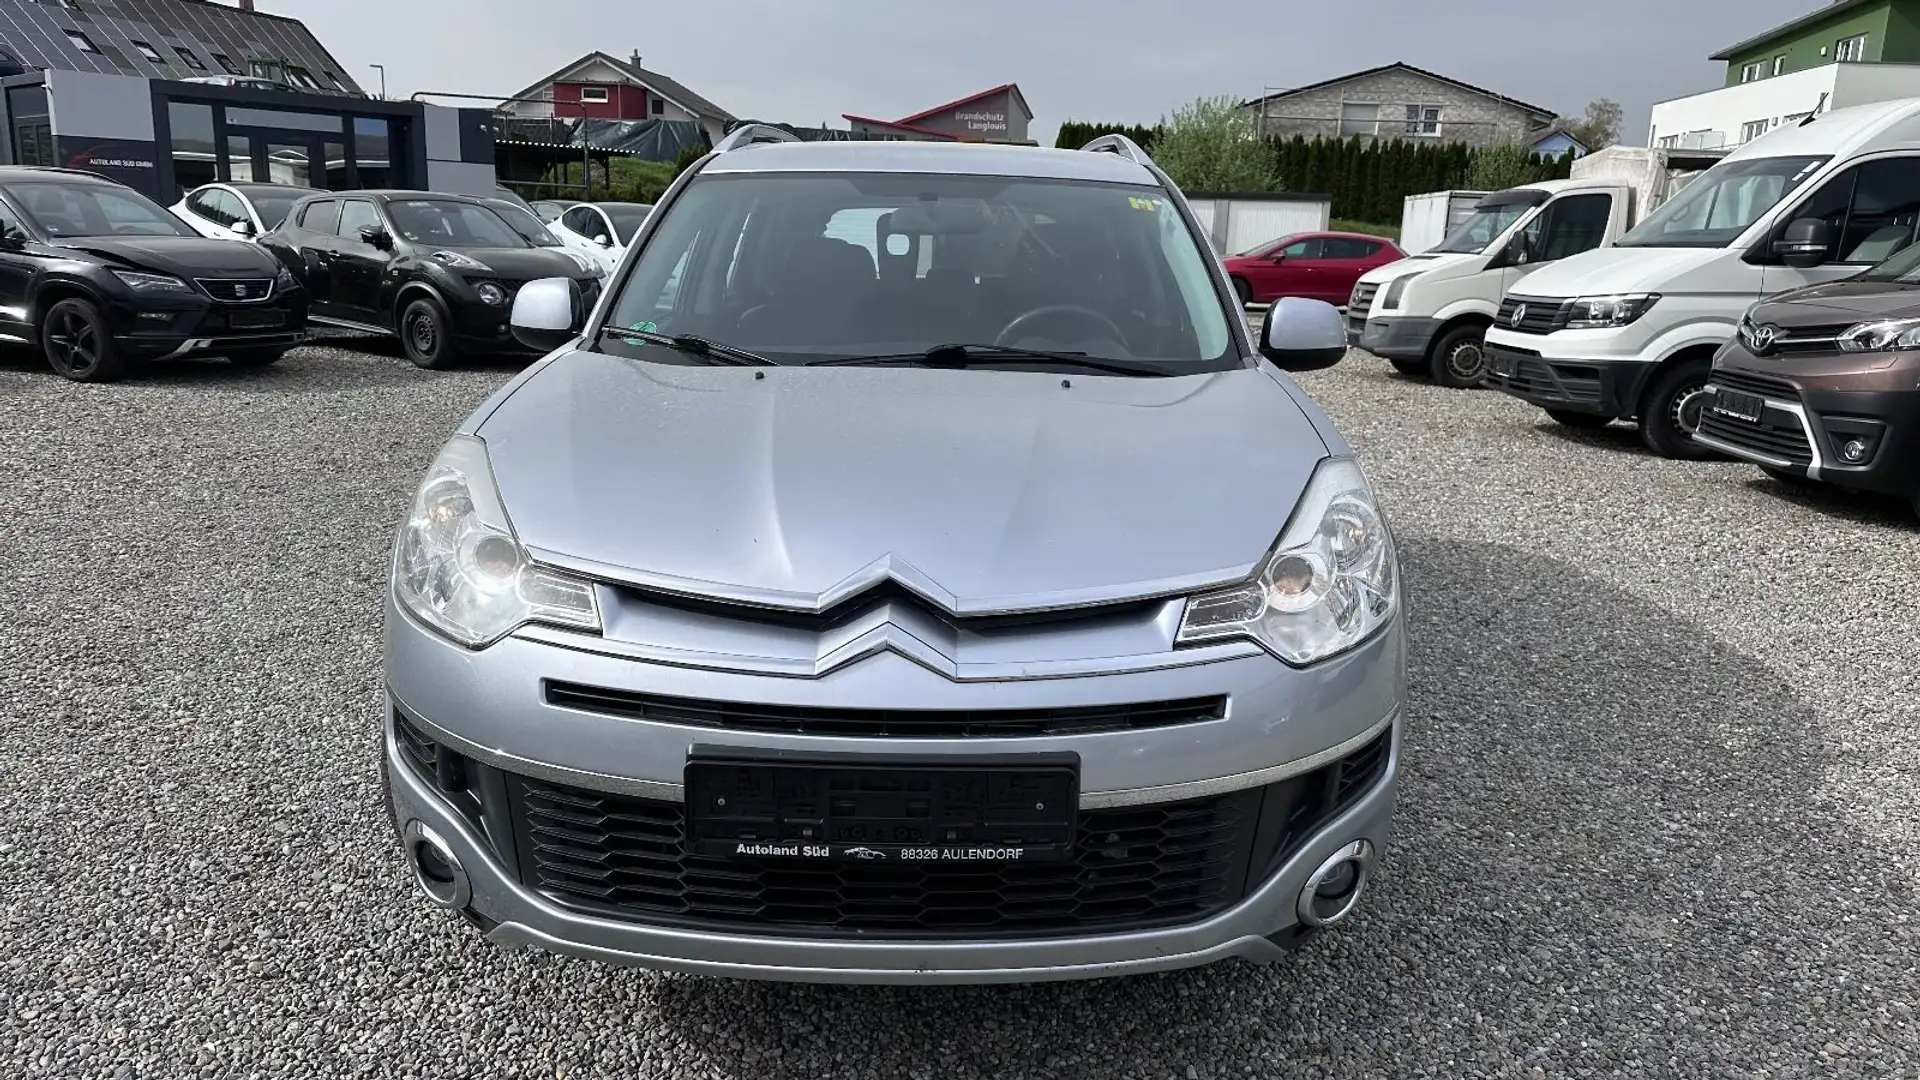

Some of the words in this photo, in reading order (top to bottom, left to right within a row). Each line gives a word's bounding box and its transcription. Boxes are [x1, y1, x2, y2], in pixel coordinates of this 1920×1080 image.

[955, 111, 1004, 121] Brandschutz
[968, 121, 1007, 131] Langlouis
[89, 158, 122, 166] AUTOLAND
[736, 843, 798, 856] Autoland
[802, 845, 829, 857] Süd
[900, 849, 938, 860] 88326
[942, 848, 1023, 860] AULENDORF
